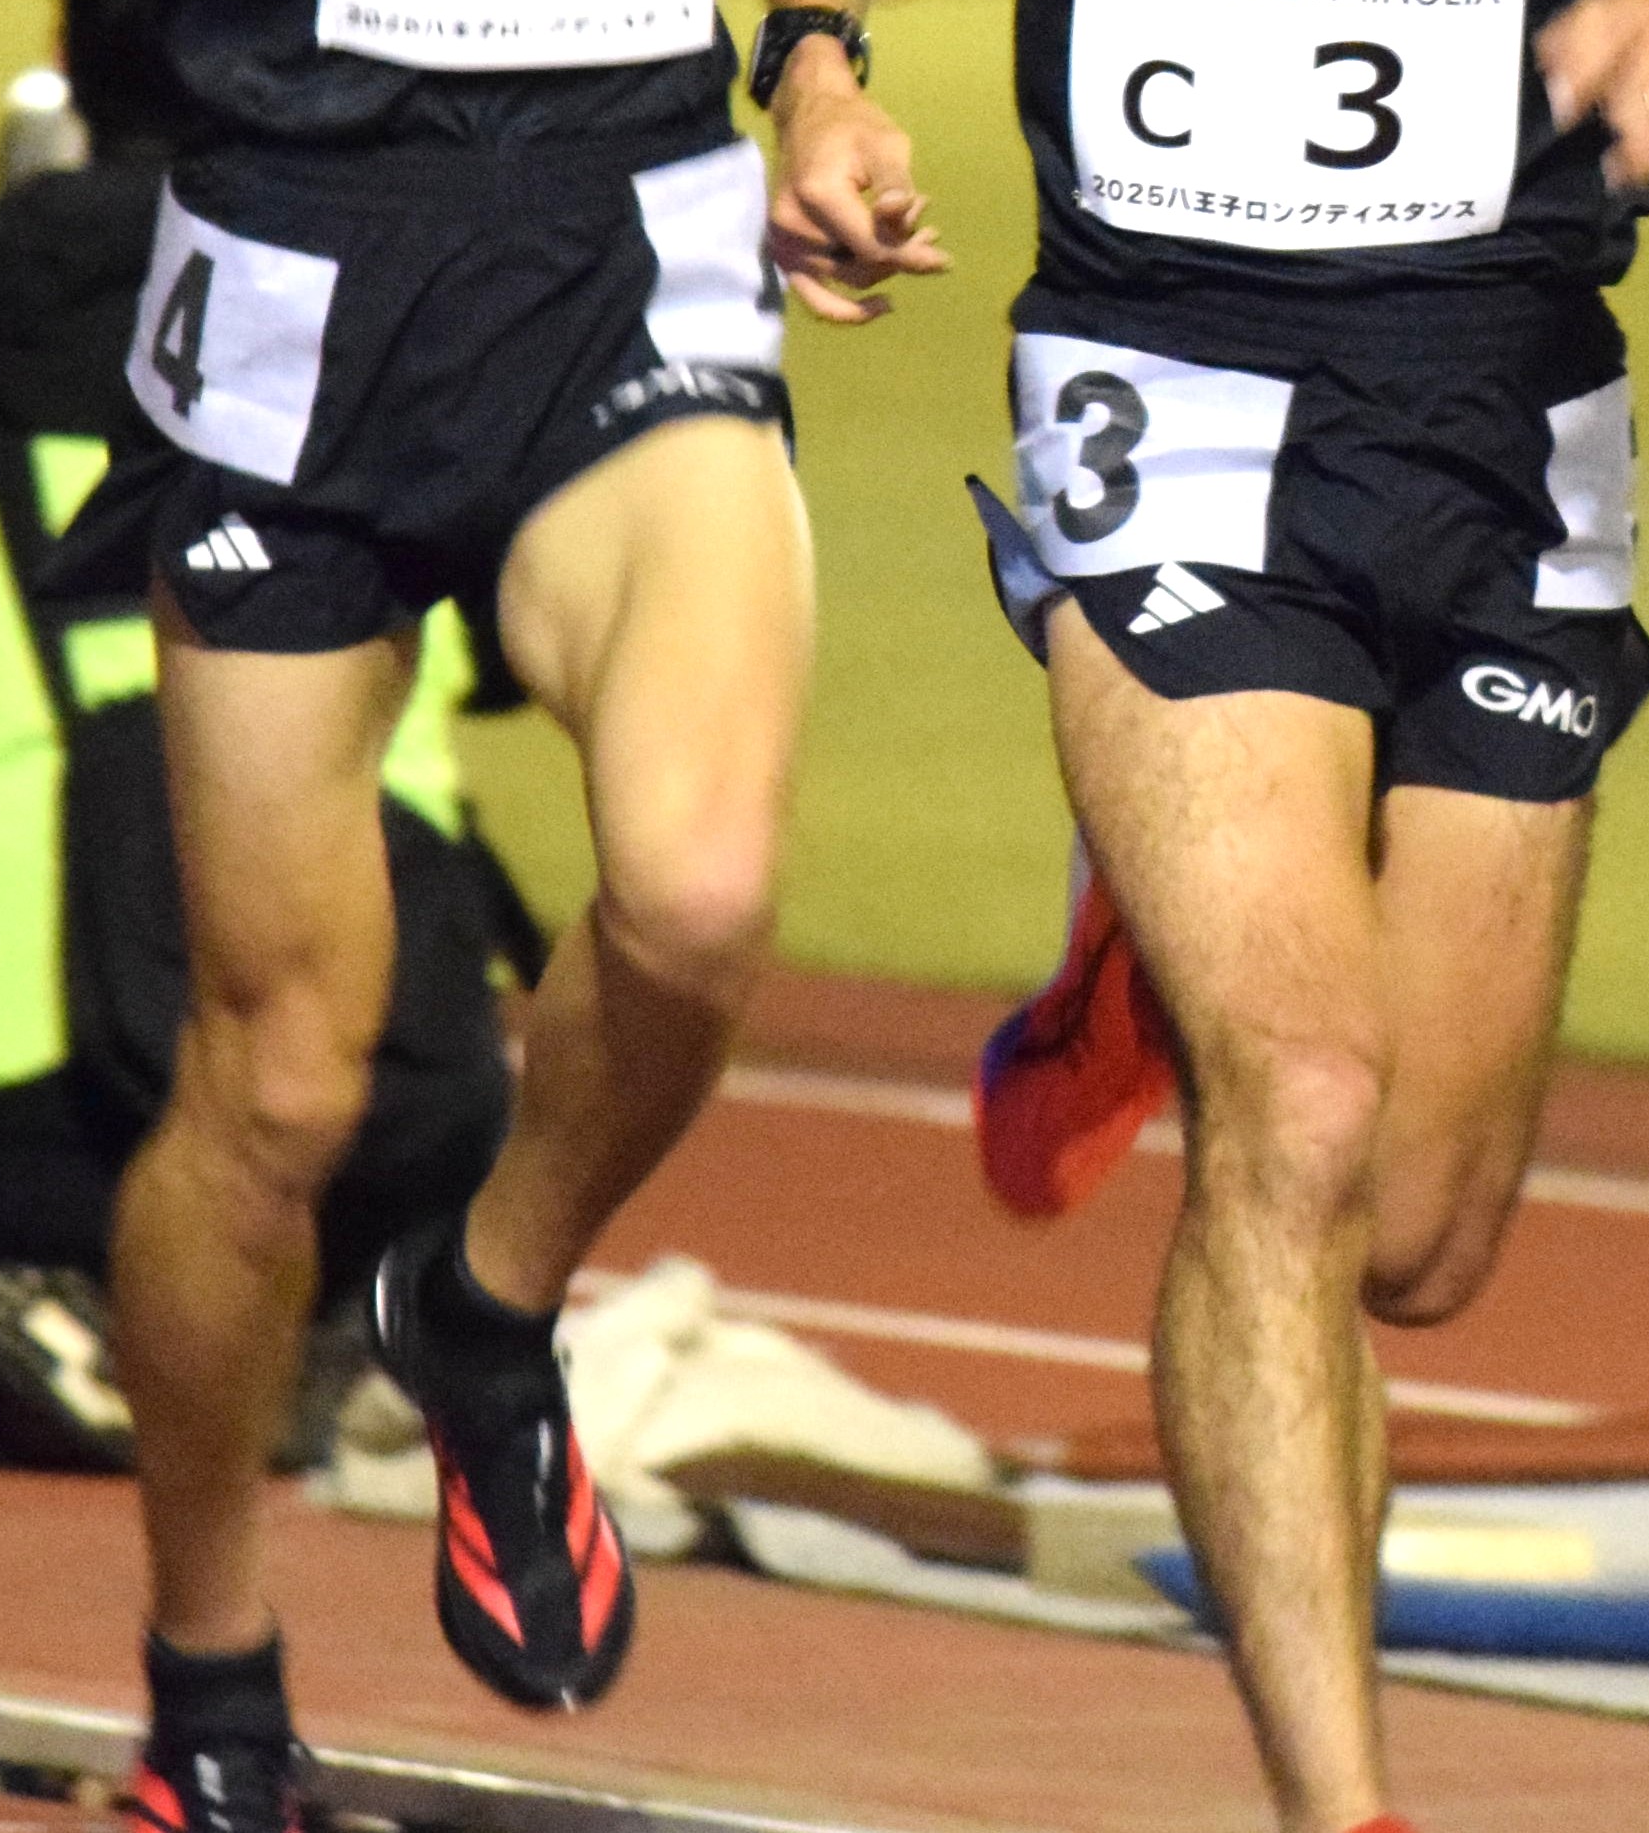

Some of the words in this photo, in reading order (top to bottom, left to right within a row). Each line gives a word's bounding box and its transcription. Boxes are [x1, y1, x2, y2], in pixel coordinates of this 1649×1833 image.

[1121, 59, 1196, 150] C
[1302, 40, 1405, 170] 3
[151, 248, 215, 422] 4
[1052, 369, 1149, 545] 3
[1461, 665, 1598, 738] GMO
